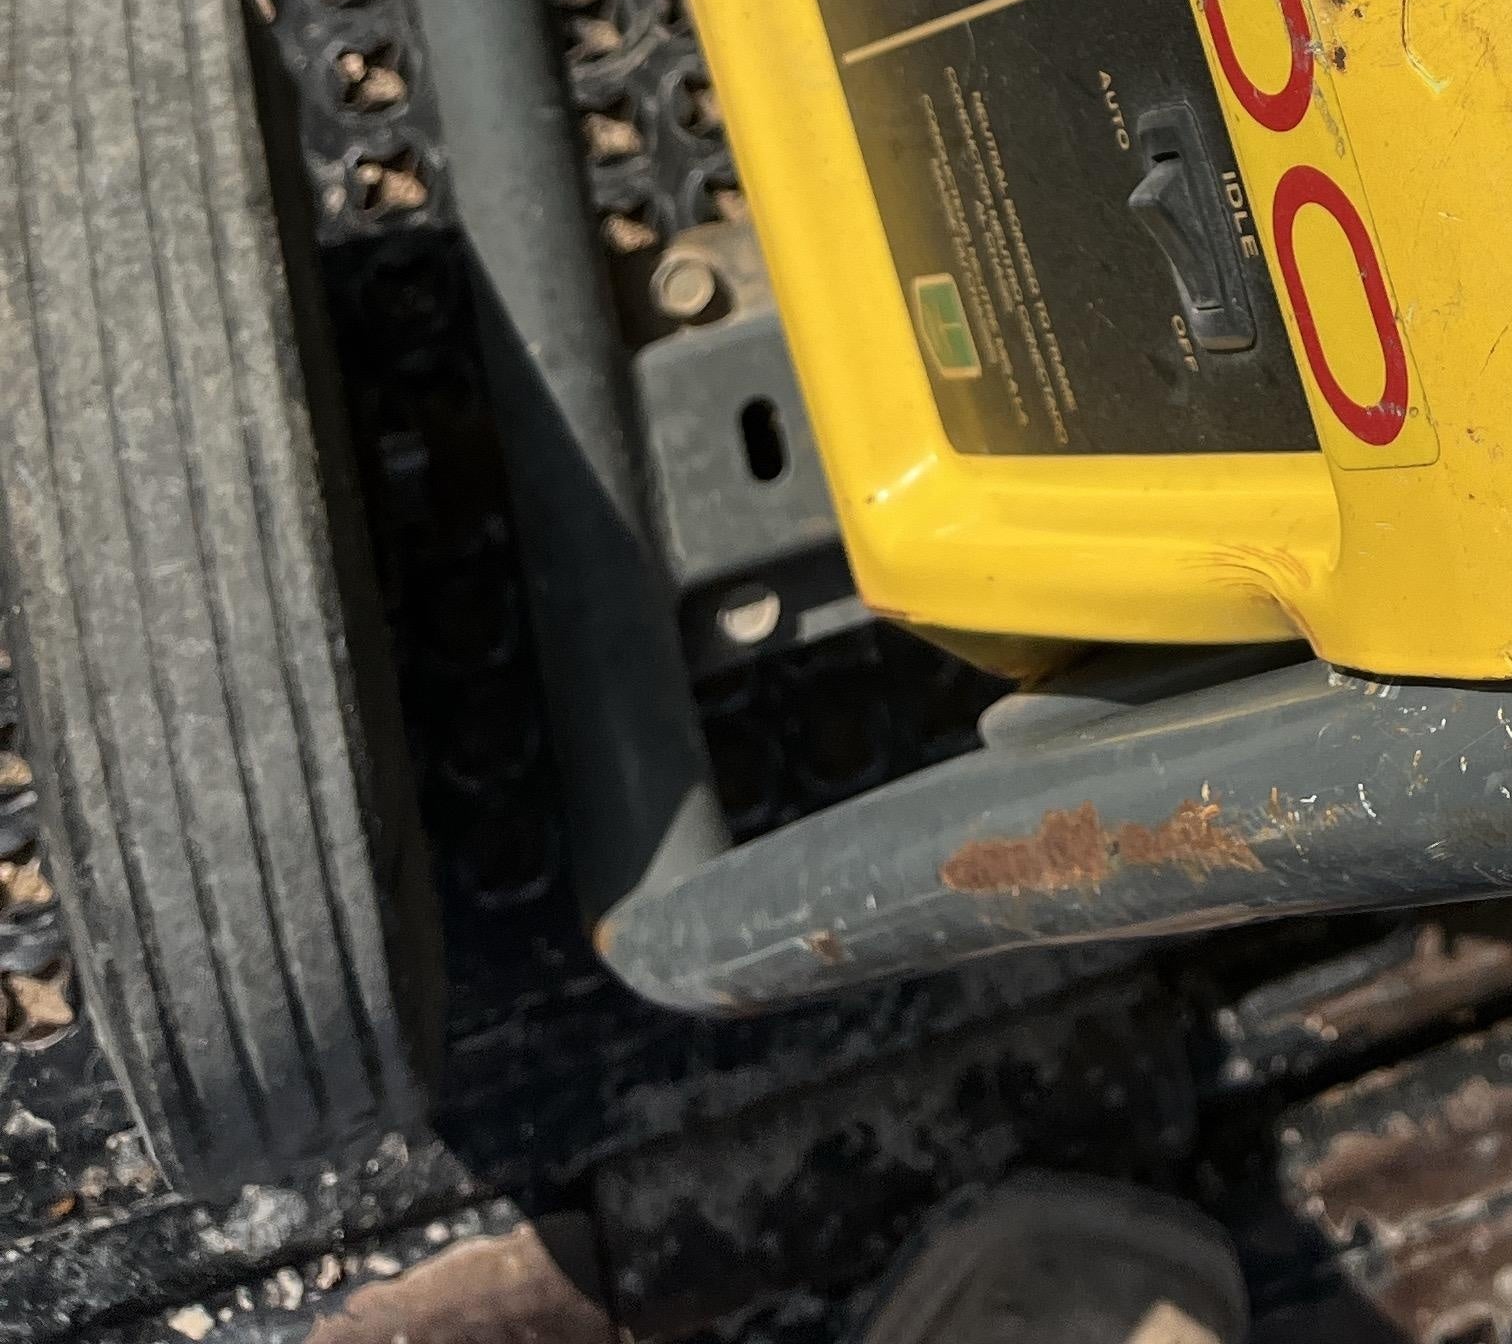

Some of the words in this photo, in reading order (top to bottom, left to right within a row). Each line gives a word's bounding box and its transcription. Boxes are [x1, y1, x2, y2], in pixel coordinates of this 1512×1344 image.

[1096, 68, 1132, 151] AUTO
[1219, 169, 1259, 259] IDLE
[1169, 313, 1199, 373] OFF
